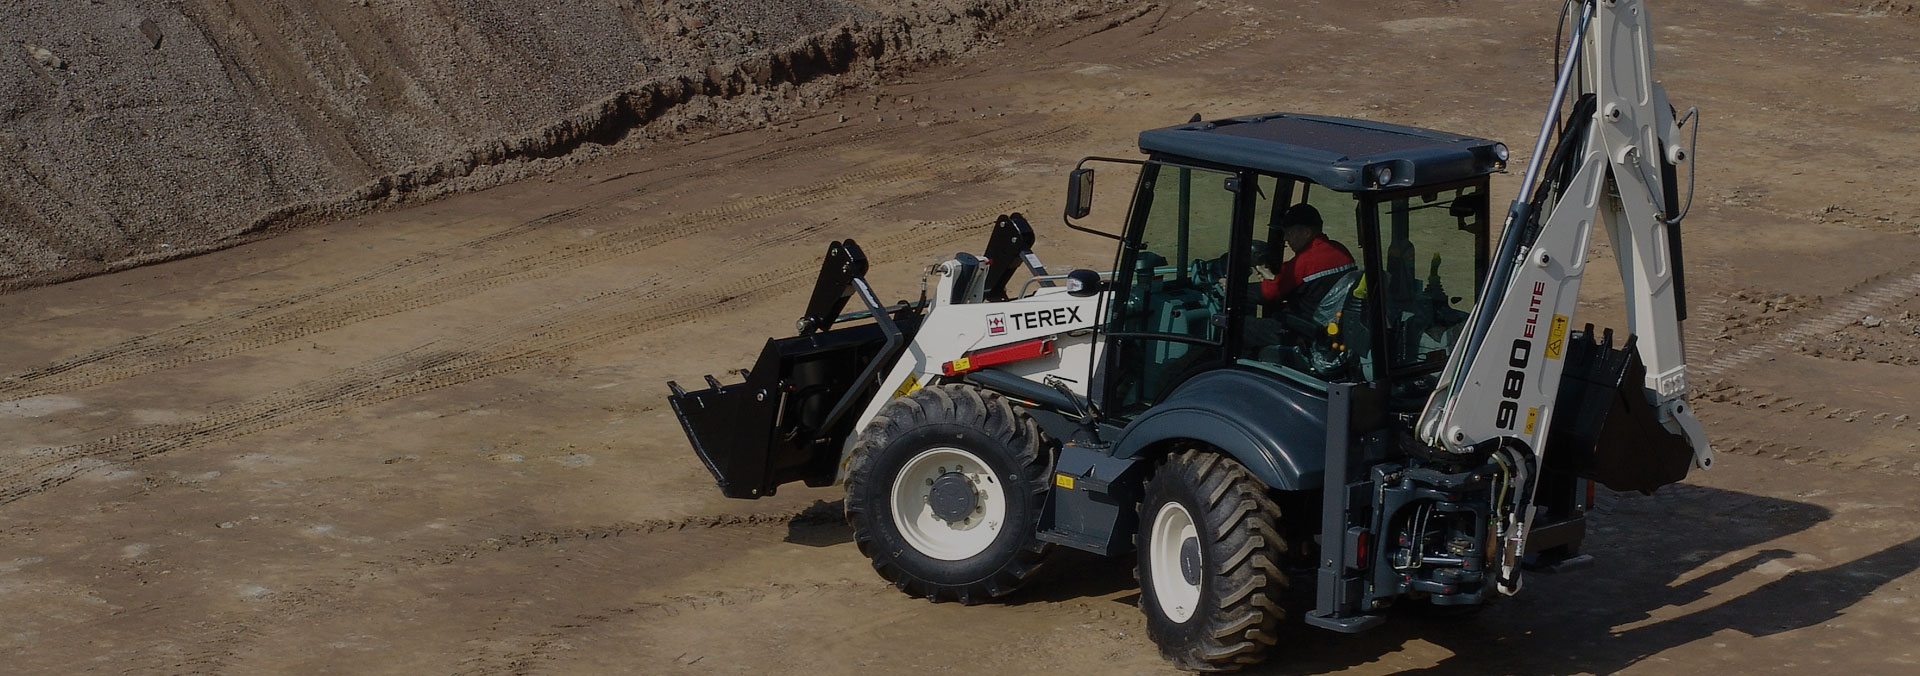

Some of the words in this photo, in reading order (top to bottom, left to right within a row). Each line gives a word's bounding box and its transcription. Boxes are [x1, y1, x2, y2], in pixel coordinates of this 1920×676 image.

[1010, 305, 1082, 330] TEREX
[1496, 338, 1531, 430] 980
[1524, 281, 1545, 338] ELITE
